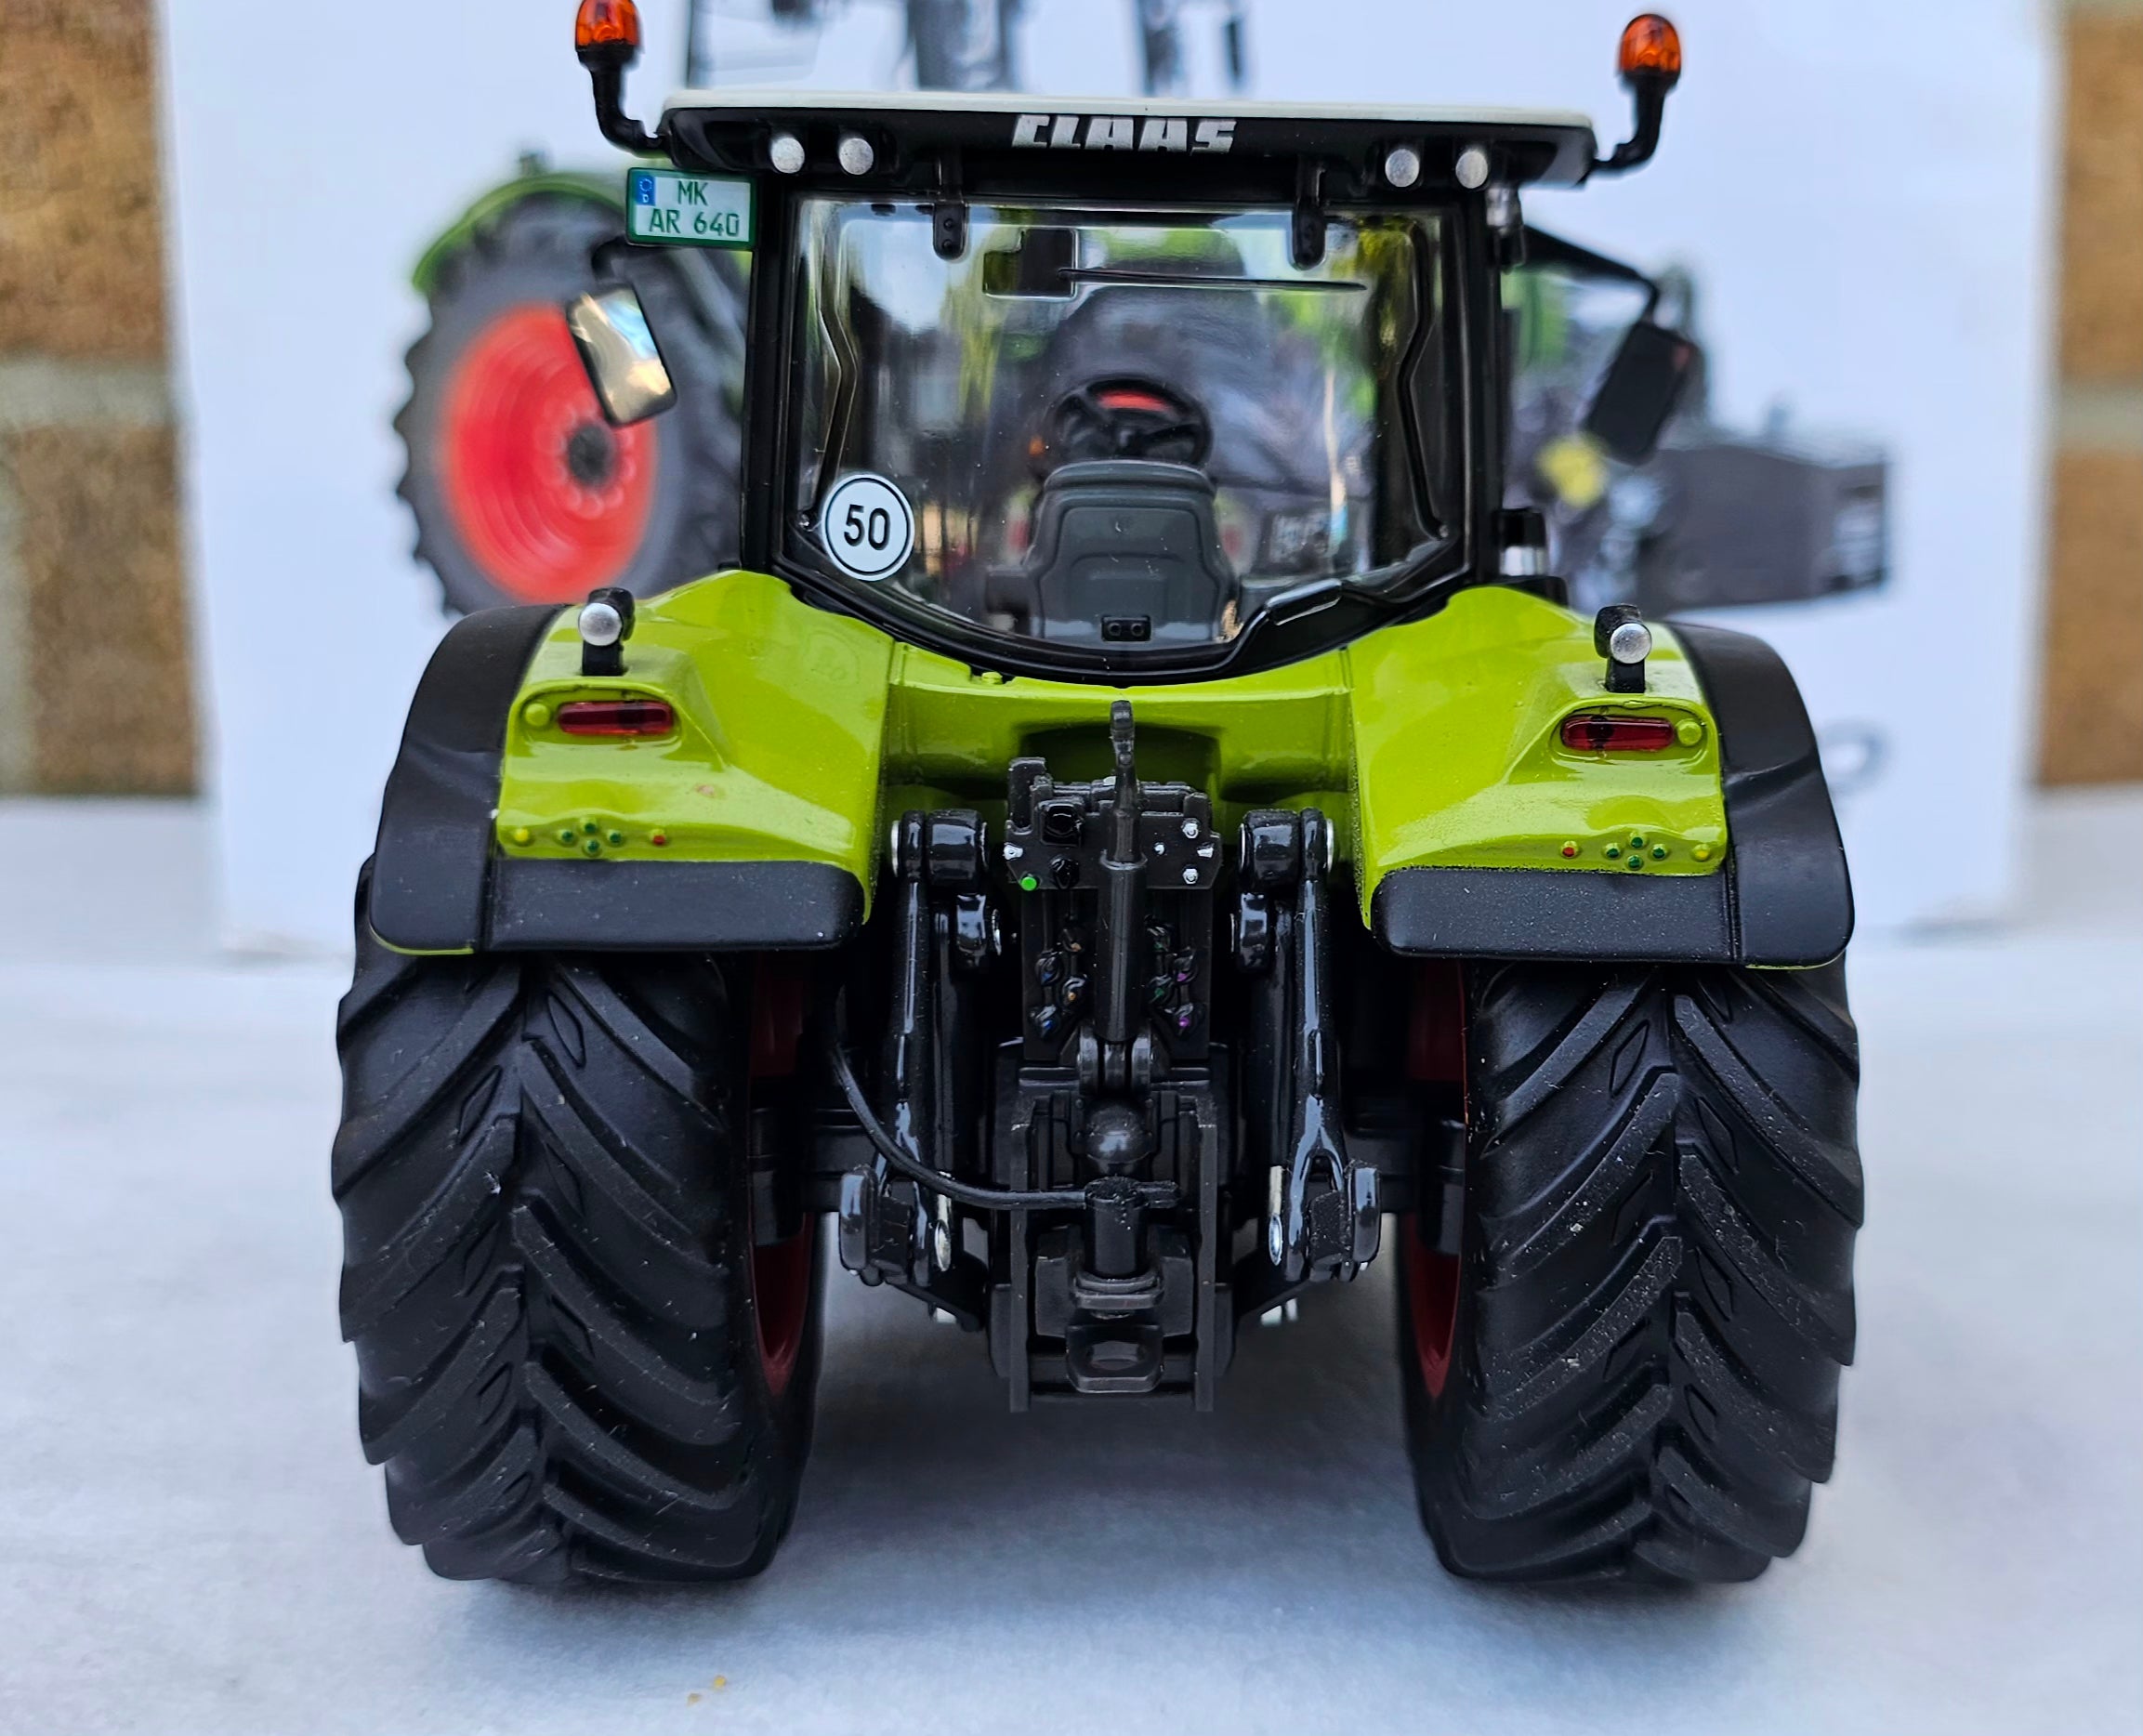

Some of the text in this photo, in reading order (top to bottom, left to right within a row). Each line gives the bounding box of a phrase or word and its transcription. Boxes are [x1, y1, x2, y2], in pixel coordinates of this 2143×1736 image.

[1011, 114, 1237, 156] CLAAS
[677, 180, 708, 206] MK
[649, 208, 740, 237] AR 640
[844, 504, 891, 551] 50
